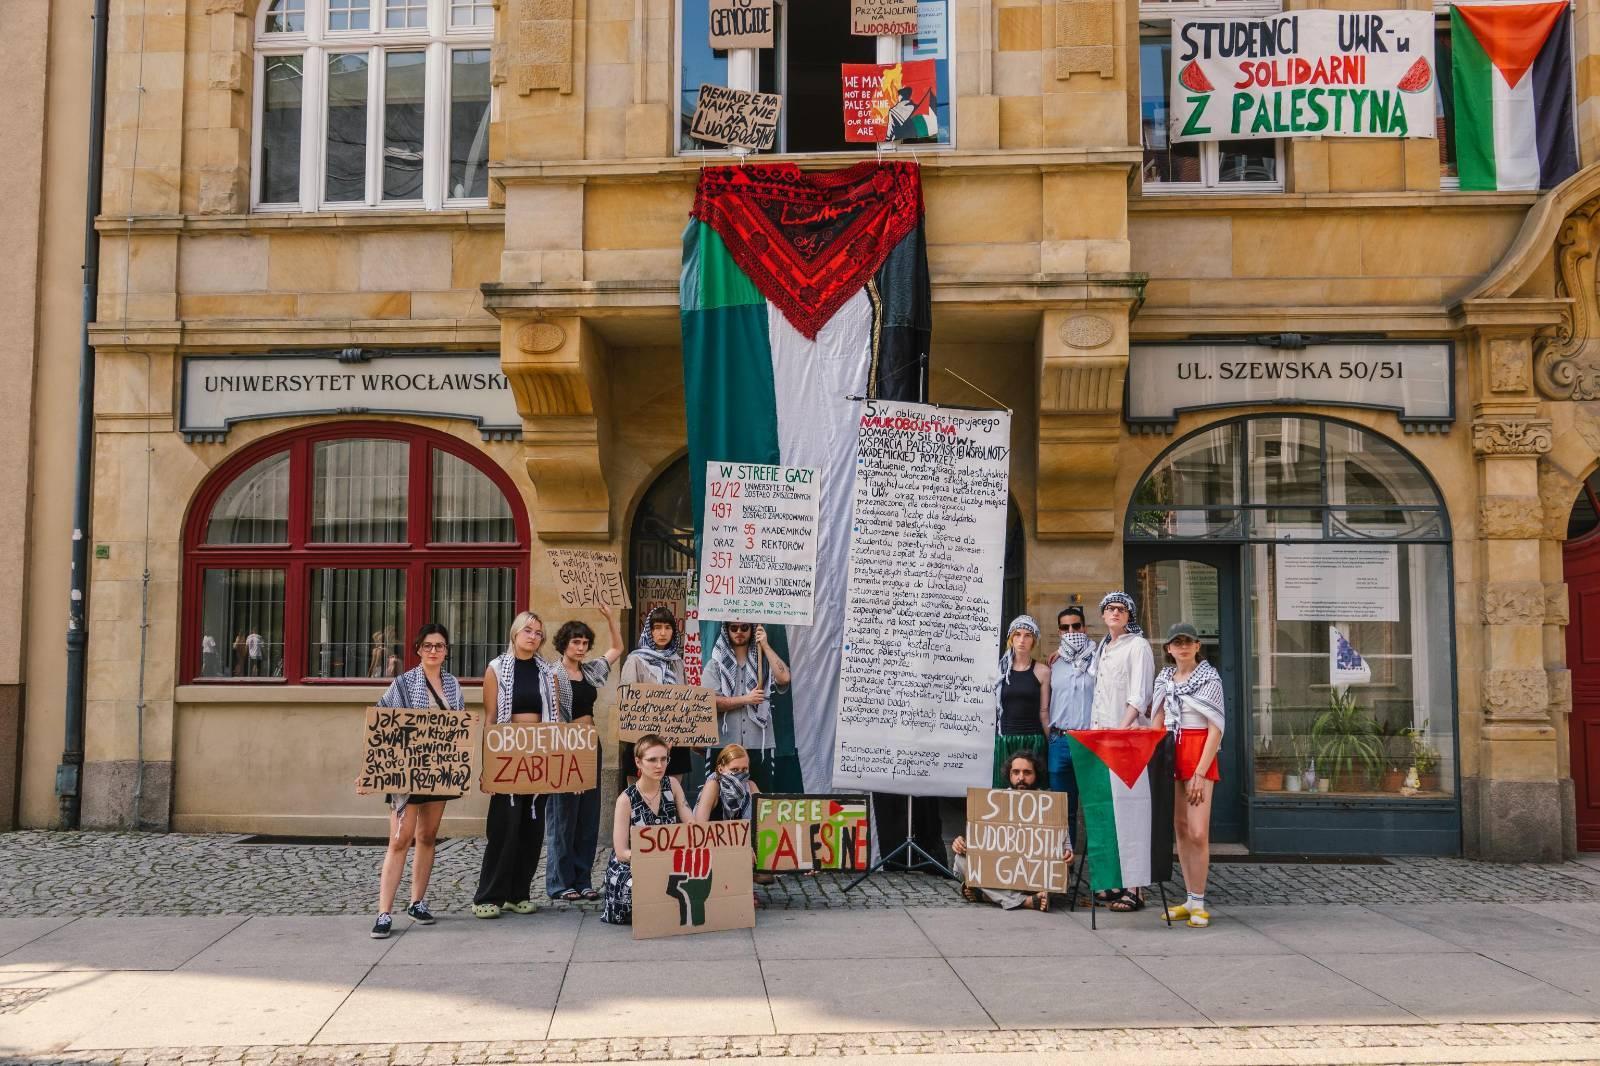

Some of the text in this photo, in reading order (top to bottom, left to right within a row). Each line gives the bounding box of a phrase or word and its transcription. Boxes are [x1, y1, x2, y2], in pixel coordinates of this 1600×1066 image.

[855, 6, 918, 16] PRZYZWOLENIE
[711, 7, 772, 36] GENOCIDE
[1180, 16, 1298, 61] STUDENCI
[1234, 55, 1366, 89] SOLIDARNI
[845, 76, 884, 89] WE MAY
[763, 95, 778, 107] NA
[874, 90, 883, 98] IN
[750, 105, 776, 120] NIE
[845, 100, 889, 109] PALESTINE
[1180, 88, 1409, 137] Z PALESTYNĄ
[857, 127, 874, 135] ARE
[1177, 361, 1404, 381] UL. SZEWSKA 50/51
[204, 373, 508, 392] UNIWERSYTET WROCŁAWSKI
[859, 428, 916, 442] DOMAGAMY
[858, 448, 916, 463] AKADEMICKIEJ
[720, 465, 815, 484] W STREFIE GAZY
[710, 481, 741, 499] 12/12
[711, 502, 733, 518] 497
[711, 524, 812, 537] W TYM 95 AKADEMIKÓW
[745, 537, 755, 549] 3
[761, 540, 805, 551] REKTORÓW
[710, 551, 734, 569] 357
[704, 573, 735, 595] 9241
[774, 577, 812, 588] STUDENTÓW
[617, 684, 641, 700] The
[695, 691, 710, 703] not
[619, 700, 629, 711] be
[631, 701, 677, 715] destroyed
[369, 709, 472, 731] Jak zmieniać
[619, 713, 637, 721] who
[620, 721, 698, 733] who watch without
[486, 724, 598, 754] OBOJĘTNOŚĆ
[403, 741, 457, 758] niewinni
[366, 758, 405, 775] skoro
[432, 750, 470, 765] chcecie
[493, 754, 584, 789] ZABIJA
[362, 776, 372, 787] z
[373, 768, 407, 790] nami
[760, 800, 822, 823] FREE
[982, 790, 1053, 824] STOP
[640, 822, 750, 853] SOLIDARITY
[967, 855, 1065, 890] W GAZIE
